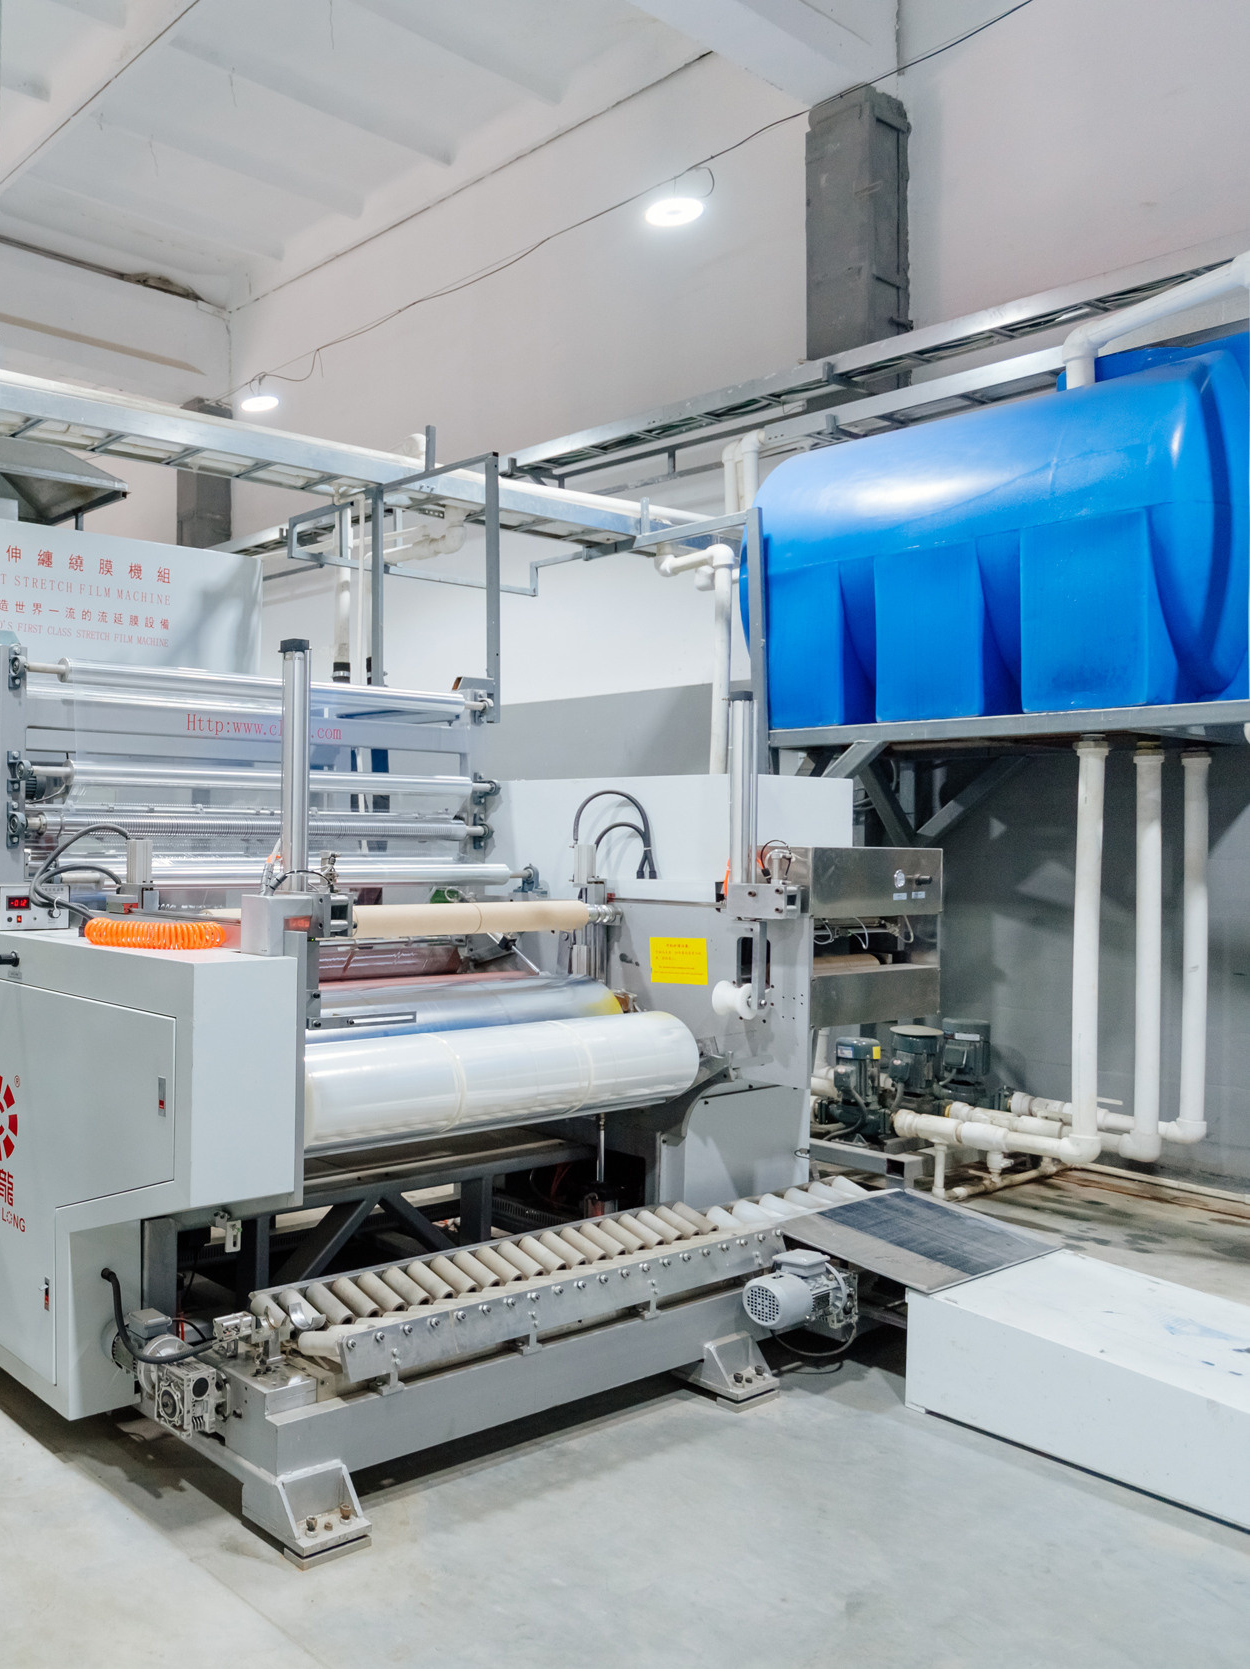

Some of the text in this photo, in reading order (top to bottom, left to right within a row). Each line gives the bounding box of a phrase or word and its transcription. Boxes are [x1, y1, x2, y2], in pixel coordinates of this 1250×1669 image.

[14, 575, 73, 593] STRETCH
[79, 583, 111, 598] FILM
[117, 588, 171, 606] MACHINE
[17, 622, 43, 634] FIRST
[47, 626, 73, 637] CLASS
[76, 629, 110, 641] STRETCH
[114, 633, 134, 644] FILM
[137, 635, 169, 648] MACHINE
[187, 713, 342, 740] Http:www.cl.com
[1, 1207, 26, 1233] LONG
